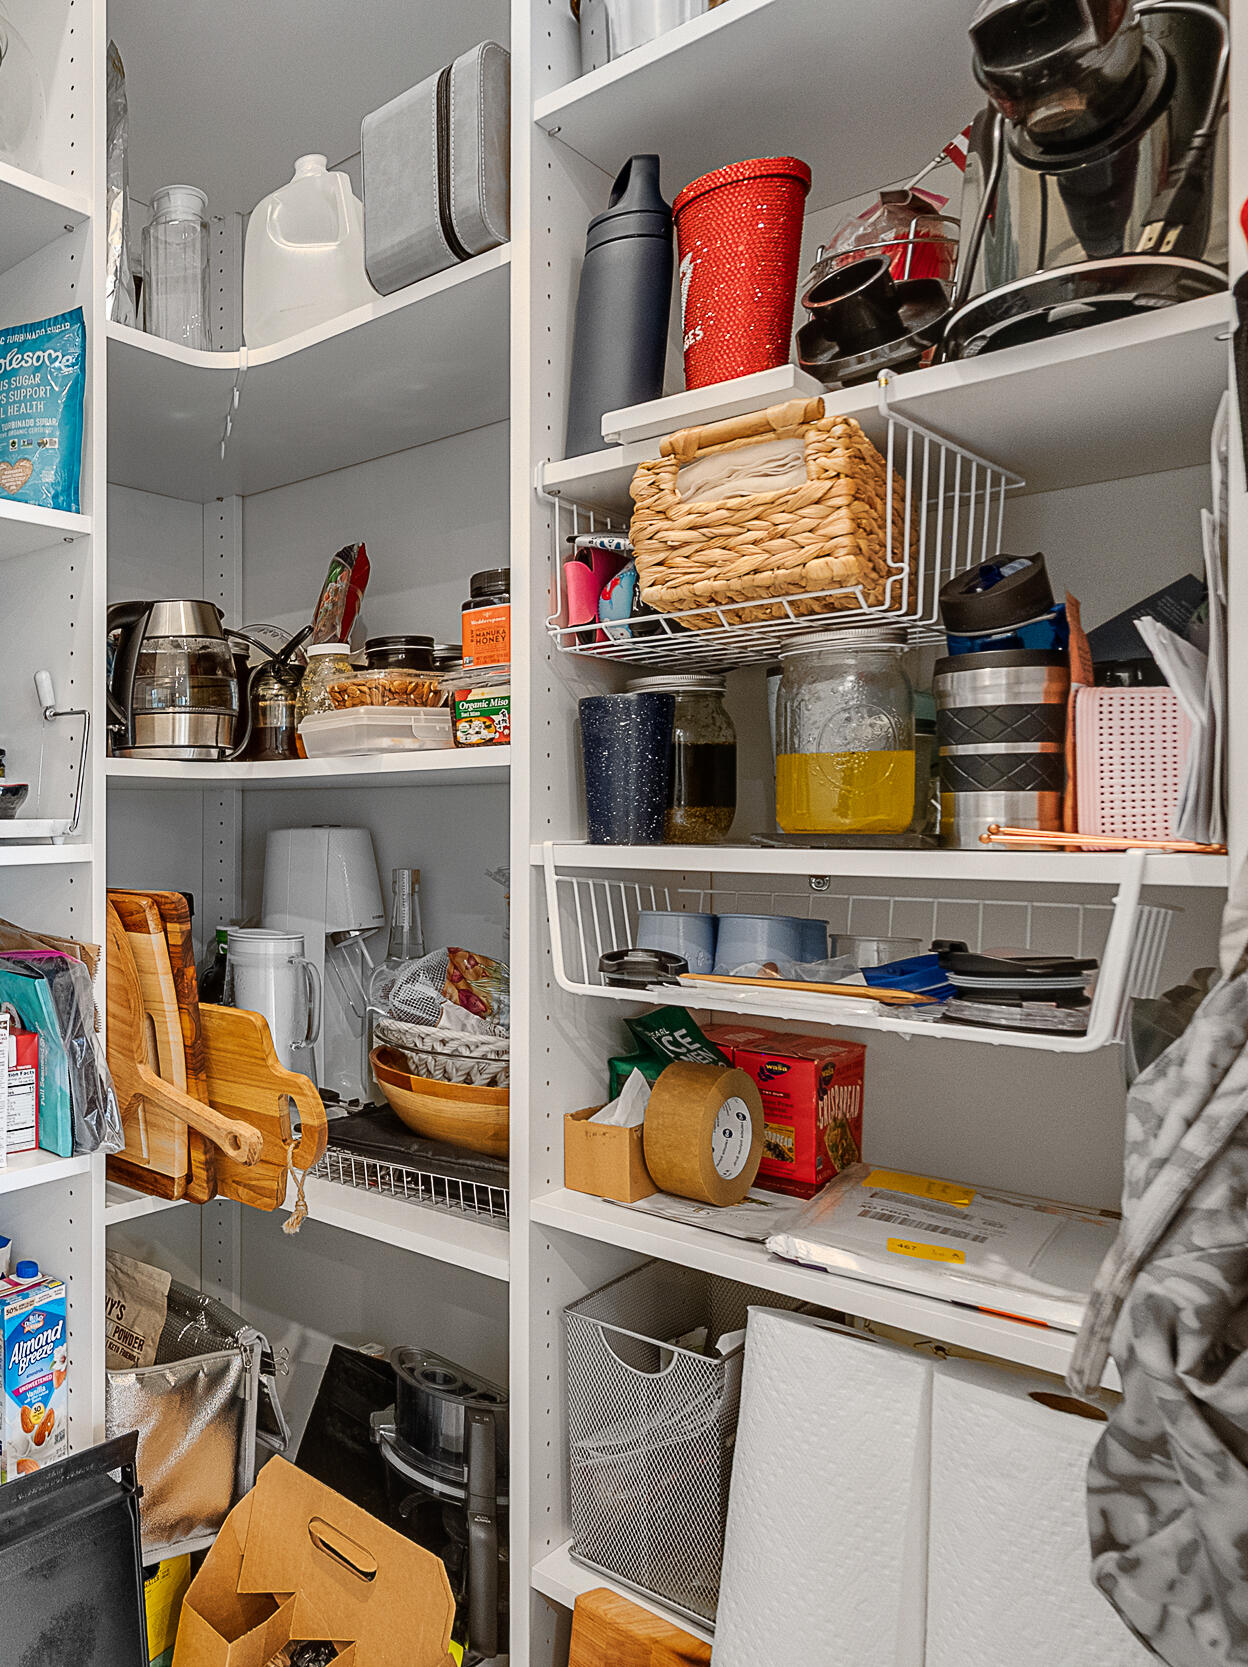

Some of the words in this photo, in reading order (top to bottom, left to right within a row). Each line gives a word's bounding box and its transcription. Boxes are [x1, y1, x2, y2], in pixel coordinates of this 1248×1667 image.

[11, 372, 41, 388] SUGAR
[9, 386, 51, 402] SUPPORT
[8, 401, 44, 416] HEALTH
[476, 630, 506, 638] MANUKA
[476, 636, 506, 646] HONEY
[459, 700, 488, 711] Organic
[490, 697, 508, 706] Miso
[765, 1063, 788, 1072] wasa
[9, 1320, 64, 1370] Almond
[112, 1325, 145, 1352] POWDER
[108, 1342, 119, 1353] KETO
[18, 1341, 54, 1376] Breeze
[19, 1375, 53, 1393] UNSWEETENED
[26, 1385, 46, 1400] Vanilla
